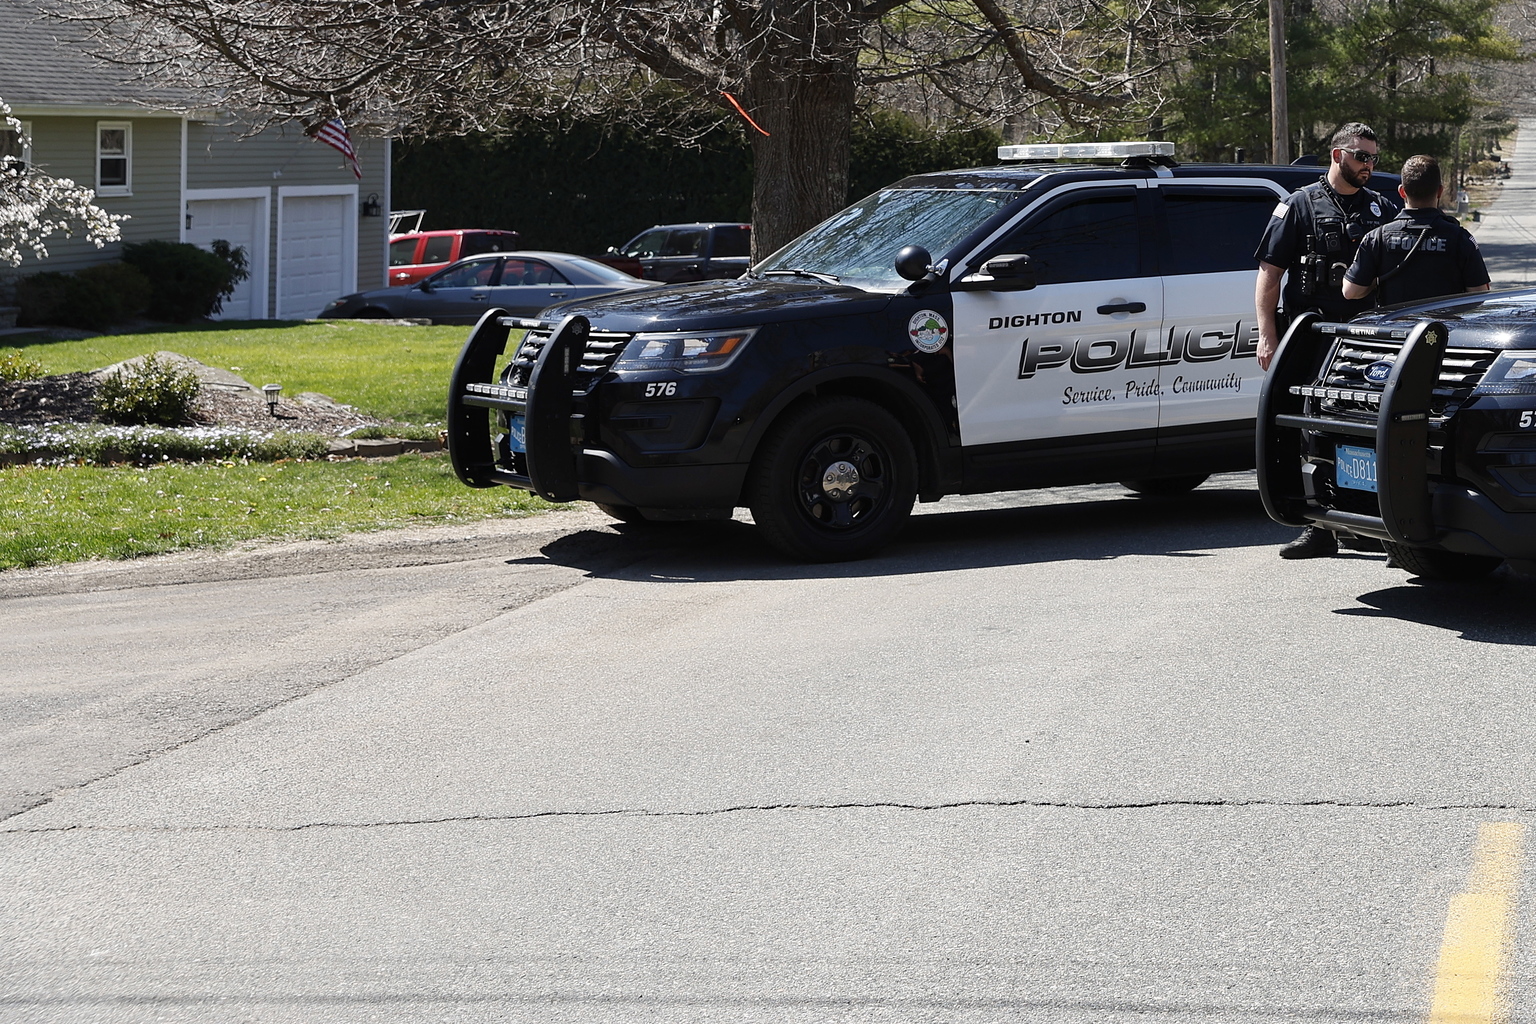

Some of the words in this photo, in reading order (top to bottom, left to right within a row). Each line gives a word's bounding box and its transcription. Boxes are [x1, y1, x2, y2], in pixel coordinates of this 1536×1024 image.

[988, 310, 1082, 329] DIGHTON
[1350, 328, 1376, 336] SETINA
[1368, 365, 1387, 378] Ford
[645, 382, 677, 397] 576
[1173, 372, 1242, 394] Community
[1337, 457, 1353, 478] POLICE
